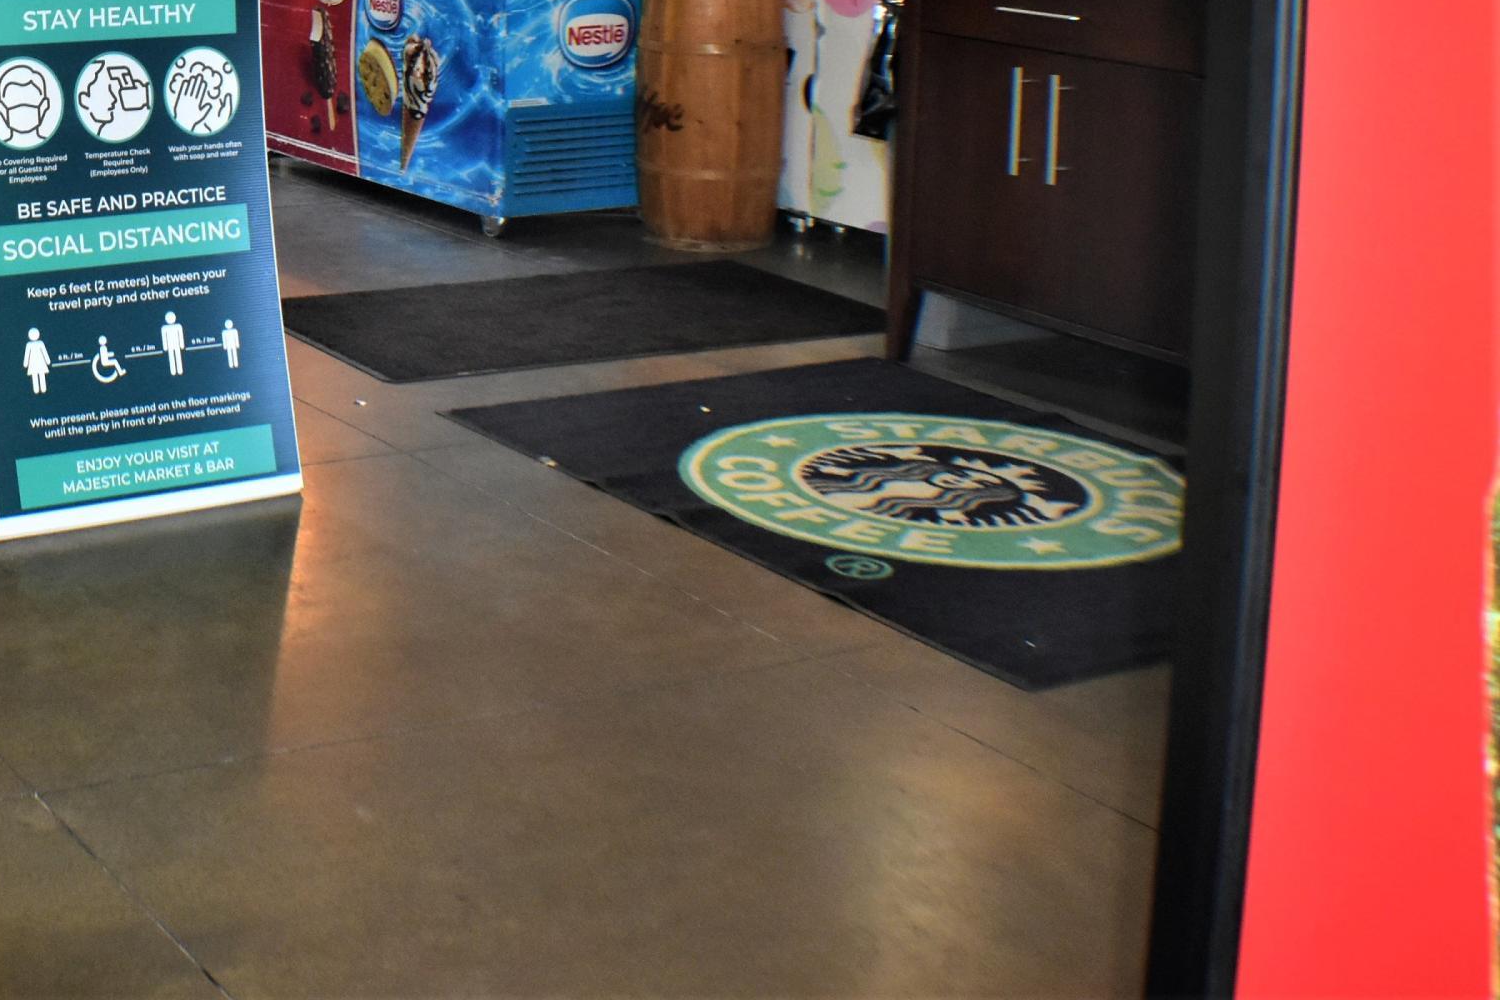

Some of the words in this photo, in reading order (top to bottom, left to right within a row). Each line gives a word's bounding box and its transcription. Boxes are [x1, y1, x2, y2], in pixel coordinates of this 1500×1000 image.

[23, 8, 82, 31] STAY
[89, 3, 196, 28] HEALTHY
[3, 156, 35, 165] Covering
[36, 154, 68, 164] Required
[84, 150, 128, 160] Temperature
[130, 147, 151, 156] Check
[168, 144, 187, 152] Wash
[188, 144, 203, 152] your
[204, 142, 224, 150] hands
[173, 153, 189, 161] with
[190, 152, 205, 160] soap
[8, 167, 17, 175] all
[18, 165, 43, 174] Guests
[90, 167, 130, 178] (Employees
[130, 165, 149, 174] Only)
[103, 158, 134, 167] Required
[9, 174, 48, 184] Employees
[17, 202, 42, 220] BE
[47, 197, 92, 217] SAFE
[97, 194, 137, 212] AND
[142, 186, 226, 208] PRACTICE
[3, 233, 93, 261] SOCIAL
[99, 218, 241, 252] DISTANCING
[27, 286, 56, 299] Keep
[59, 283, 67, 295] 6
[69, 282, 92, 294] feet
[94, 279, 105, 293] (2
[107, 274, 150, 290] meters)
[152, 271, 200, 285] between
[202, 268, 227, 282] your
[49, 297, 81, 311] travel
[84, 295, 113, 310] party
[116, 290, 137, 304] and
[140, 289, 170, 301] other
[172, 285, 210, 297] Guests
[30, 417, 59, 429] When
[60, 411, 99, 426] present,
[100, 407, 129, 420] please
[130, 402, 156, 414] stand
[158, 402, 170, 411] on
[171, 399, 187, 409] the
[188, 396, 208, 407] floor
[209, 391, 251, 403] markings
[44, 426, 66, 439] until
[68, 425, 84, 436] the
[86, 421, 110, 434] party
[111, 420, 121, 430] in
[122, 417, 145, 428] front
[147, 414, 156, 424] of
[157, 413, 175, 425] you
[176, 409, 206, 420] moves
[206, 402, 241, 416] forward
[76, 455, 122, 474] ENJOY
[124, 449, 164, 467] YOUR
[166, 443, 200, 460] VISIT
[203, 441, 220, 455] AT
[62, 472, 131, 495] MAJESTIC
[134, 463, 191, 484] MARKET
[193, 462, 204, 475] &
[206, 457, 235, 473] BAR
[826, 420, 1184, 543] STARBUCKS
[716, 455, 958, 555] COFFEE
